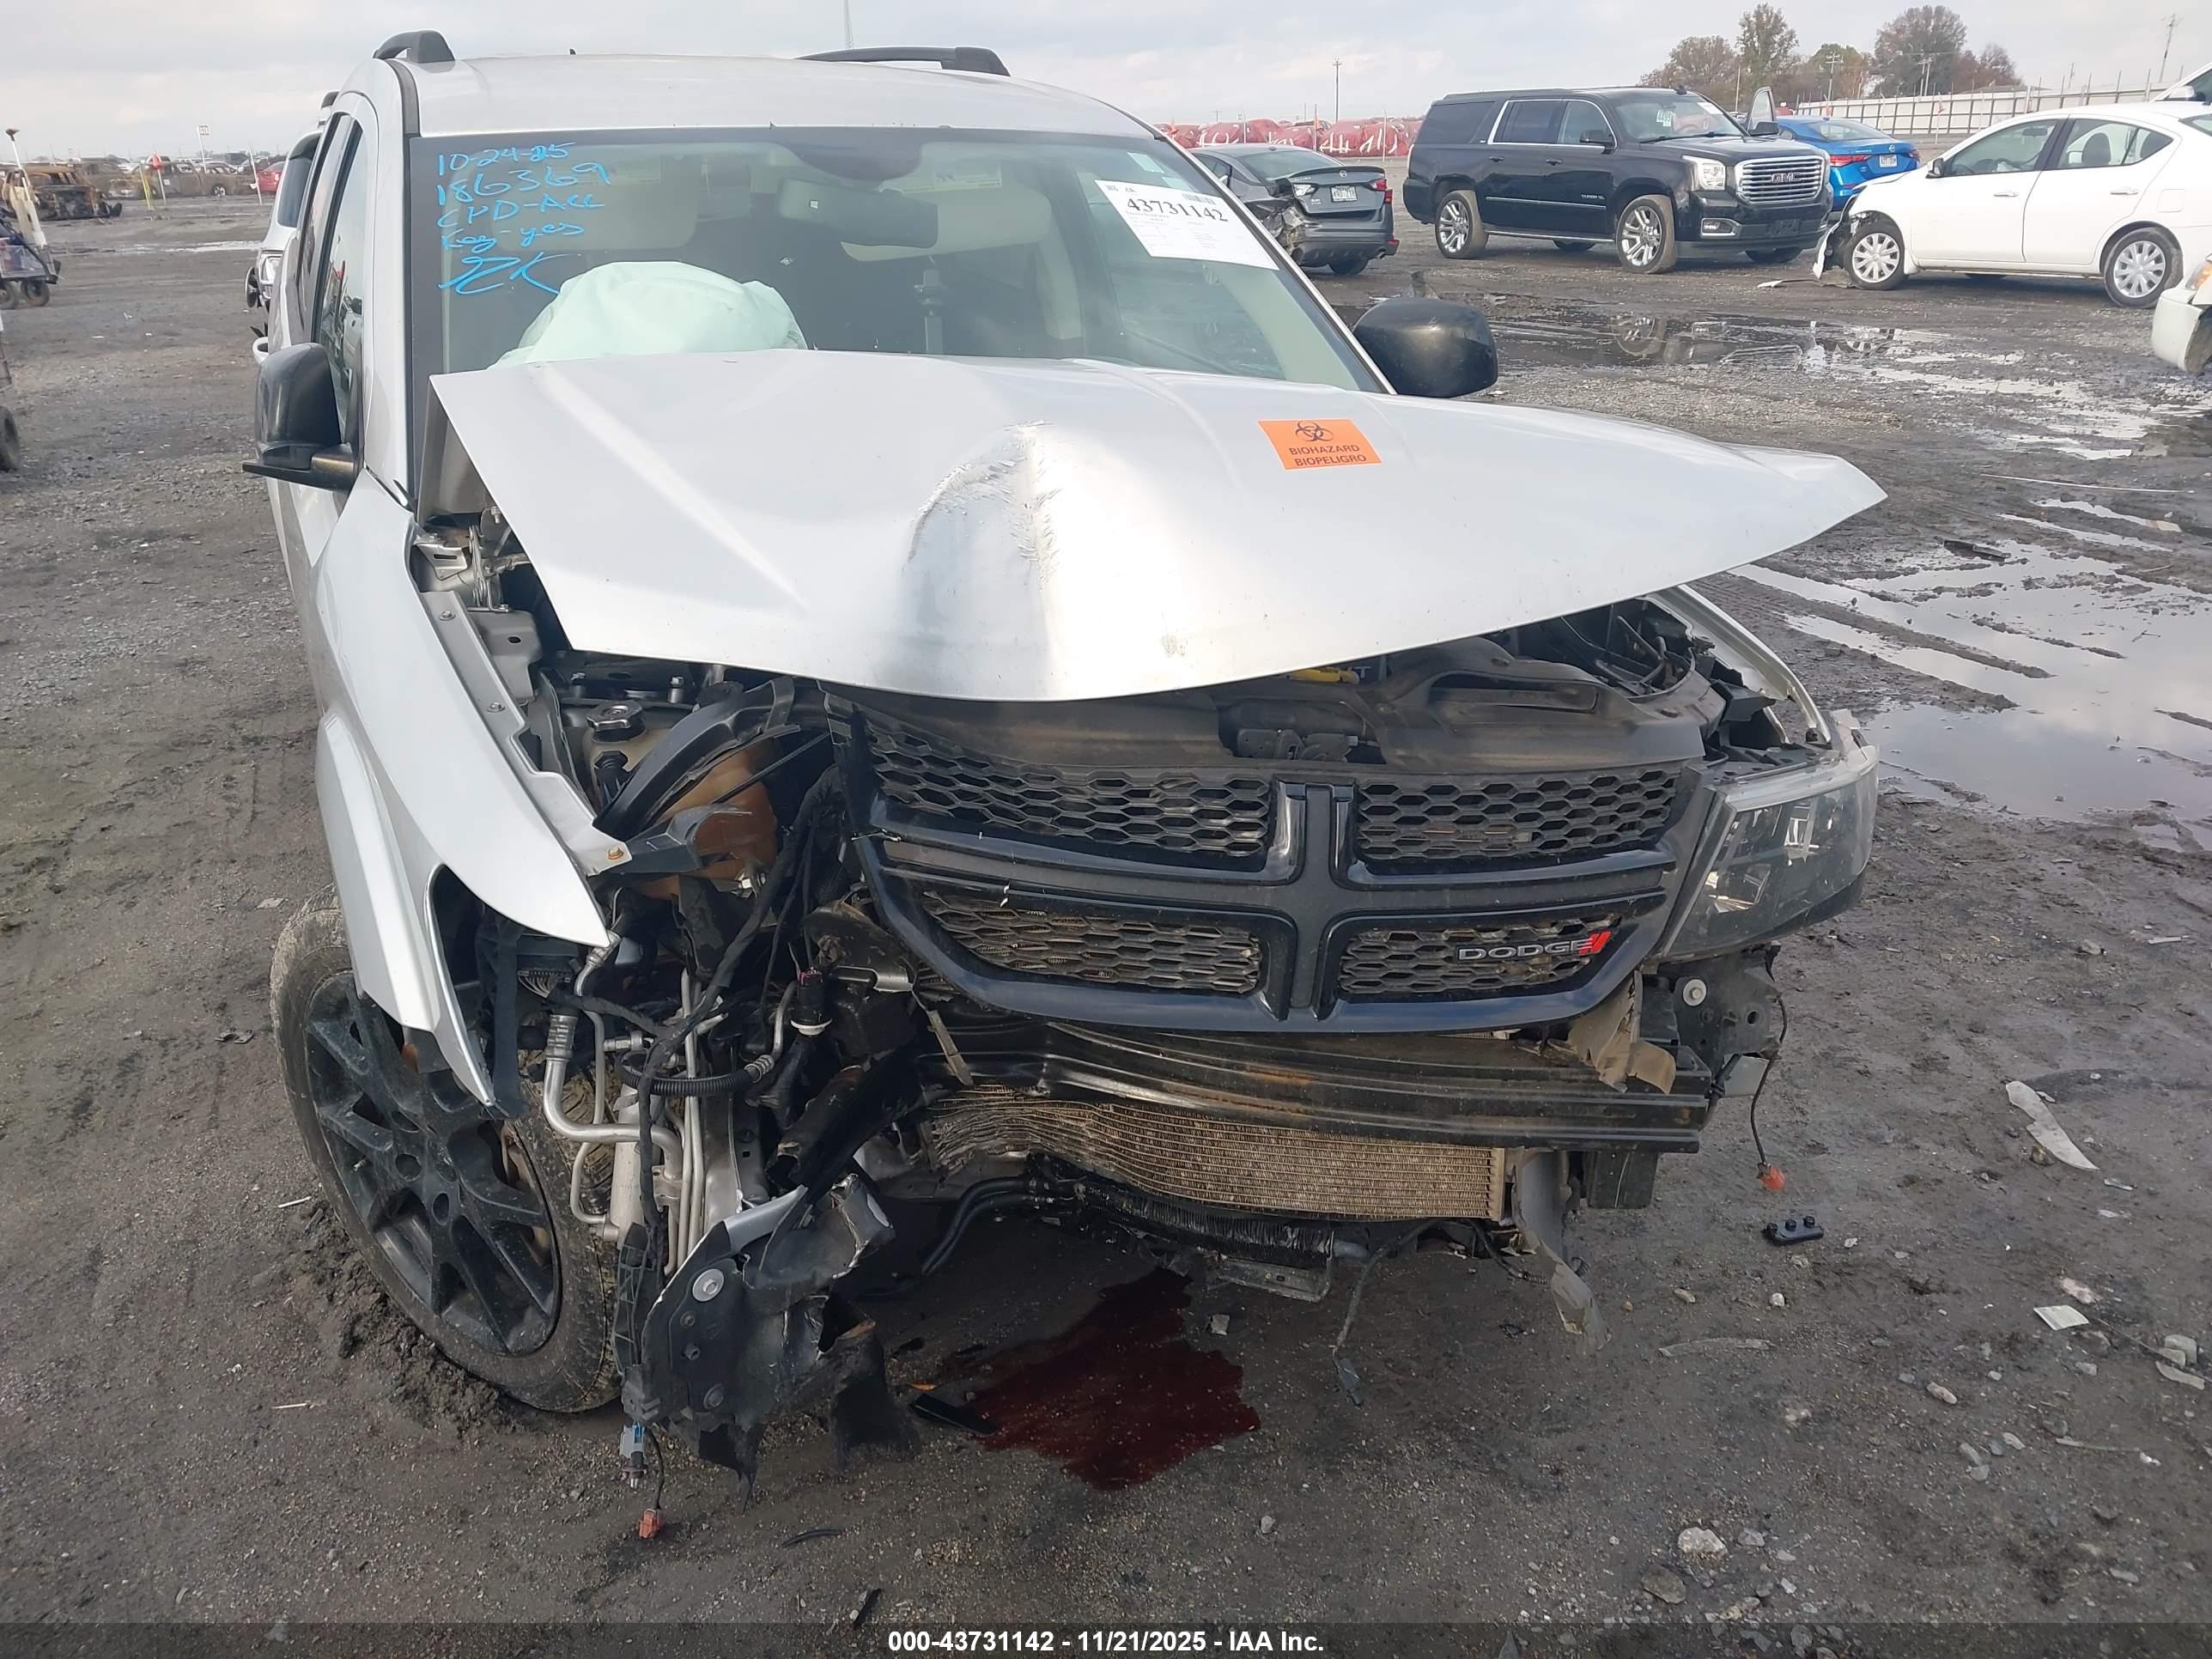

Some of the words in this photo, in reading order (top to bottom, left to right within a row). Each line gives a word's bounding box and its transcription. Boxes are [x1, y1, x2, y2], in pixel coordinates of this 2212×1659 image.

[1771, 173, 1801, 183] GMC
[1127, 198, 1229, 222] 43731142
[1289, 444, 1360, 456] BIOHAZARD
[1294, 454, 1367, 466] BIOPELIGRO
[1459, 938, 1593, 961] DODGE
